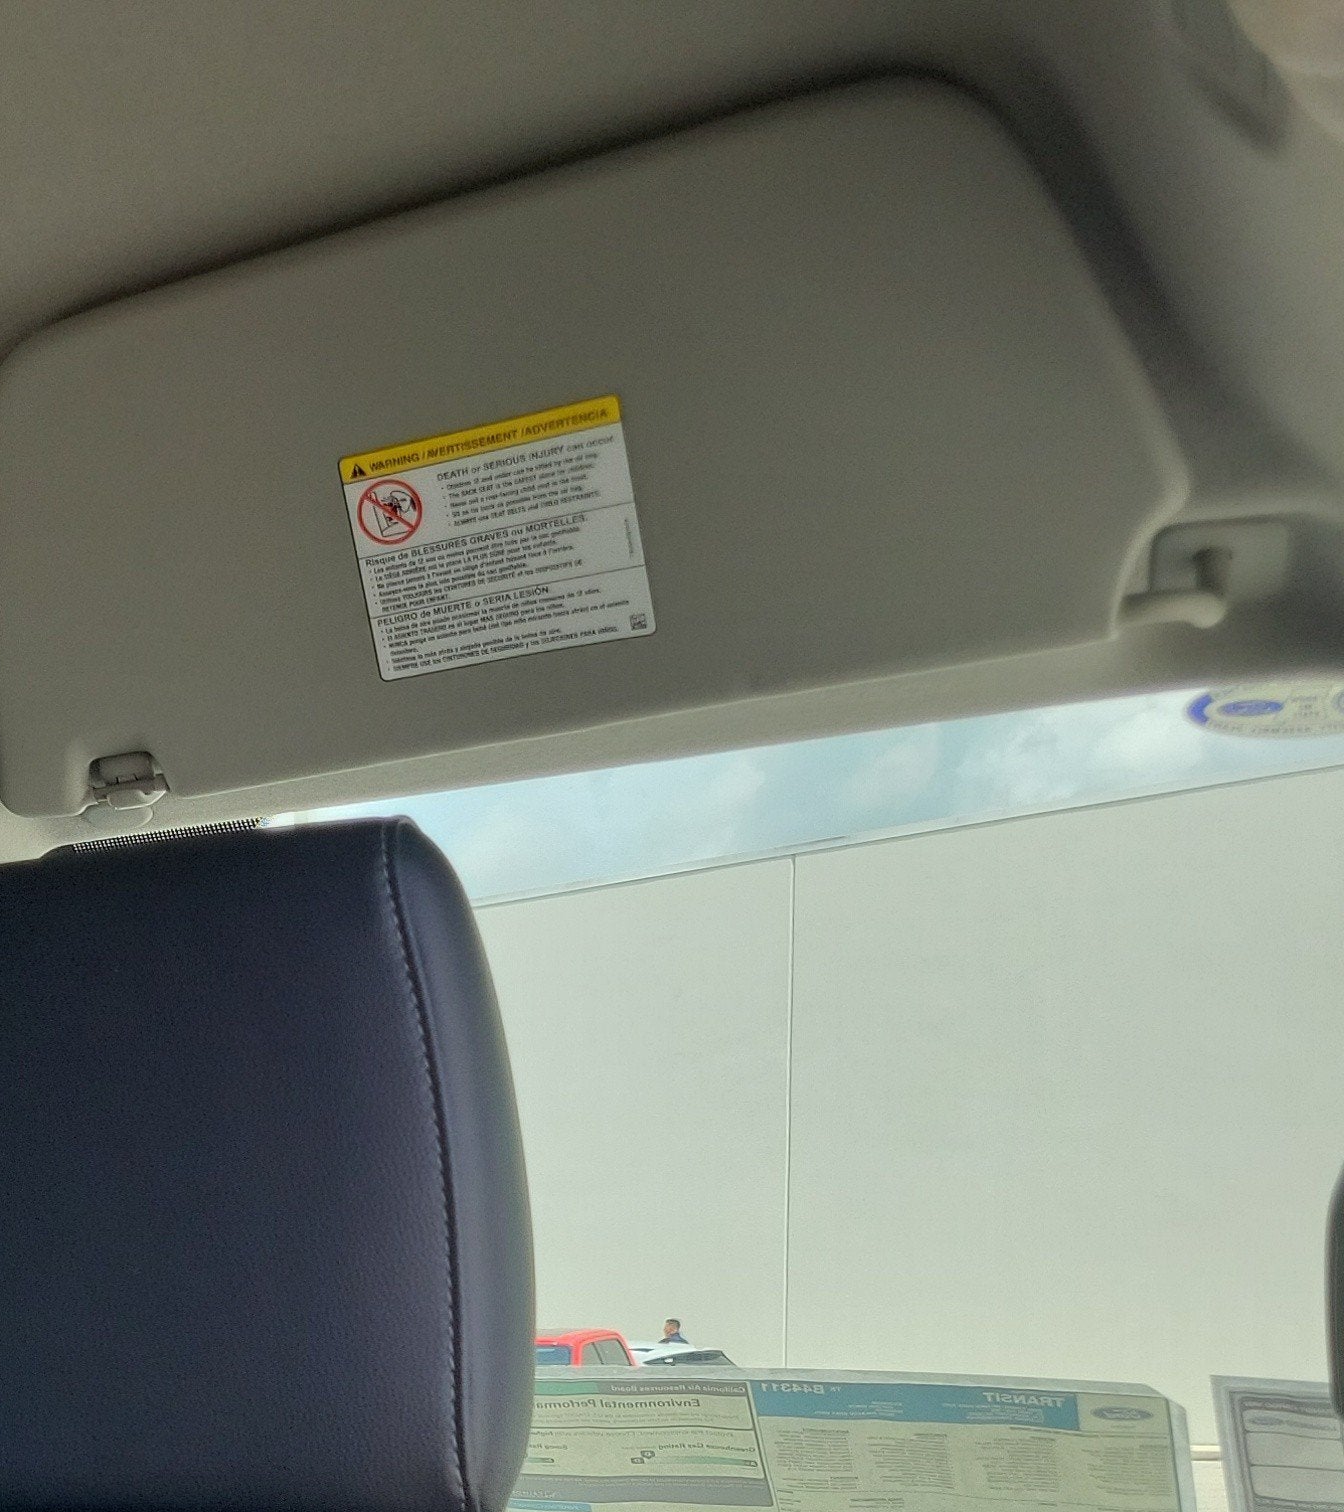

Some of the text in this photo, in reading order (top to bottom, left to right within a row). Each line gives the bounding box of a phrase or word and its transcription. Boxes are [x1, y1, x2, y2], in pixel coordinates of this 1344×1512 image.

[368, 450, 420, 472] WARNING
[436, 466, 469, 482] DEATH
[470, 464, 481, 474] or
[483, 454, 526, 471] SERIOUS
[527, 445, 564, 462] INJURY
[364, 552, 396, 568] Risque
[396, 550, 409, 561] de
[410, 537, 468, 559] BLESSURES
[468, 529, 509, 547] GRAVES
[510, 526, 523, 538] ou
[376, 610, 418, 627] PELIGRO
[419, 608, 432, 619] de
[432, 600, 472, 617] MUERTE
[482, 592, 512, 607] SERIA
